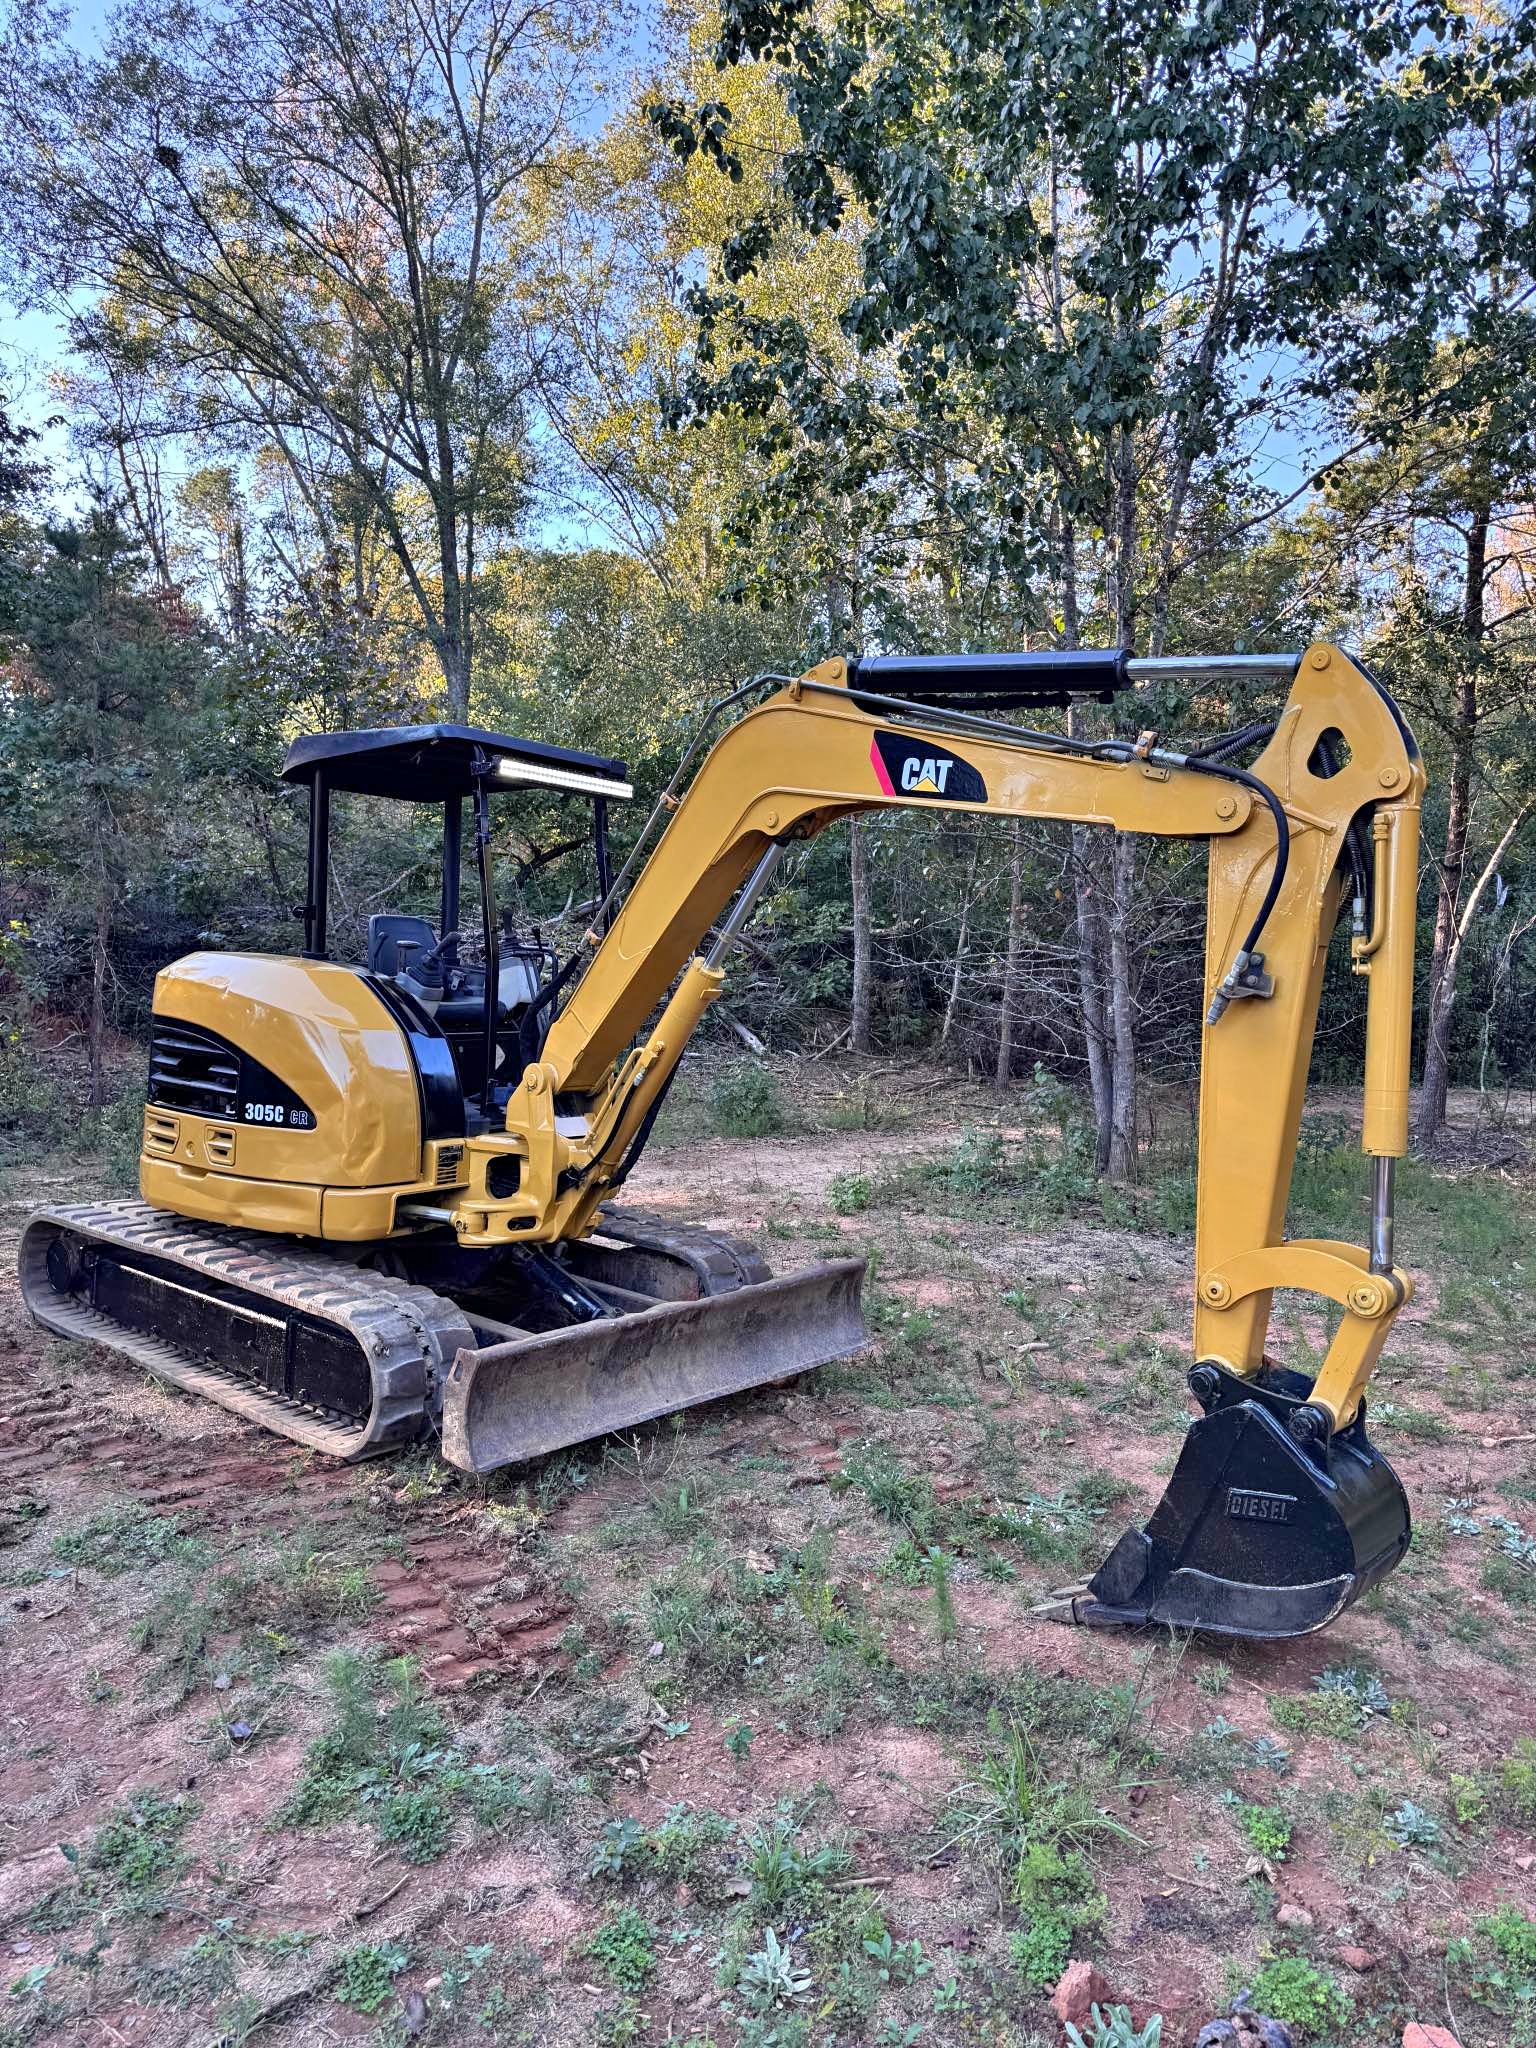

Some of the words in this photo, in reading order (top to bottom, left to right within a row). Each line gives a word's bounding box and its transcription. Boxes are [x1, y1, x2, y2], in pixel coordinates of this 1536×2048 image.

[901, 757, 953, 793] CAT
[244, 1102, 284, 1123] 305C
[290, 1109, 308, 1125] CR
